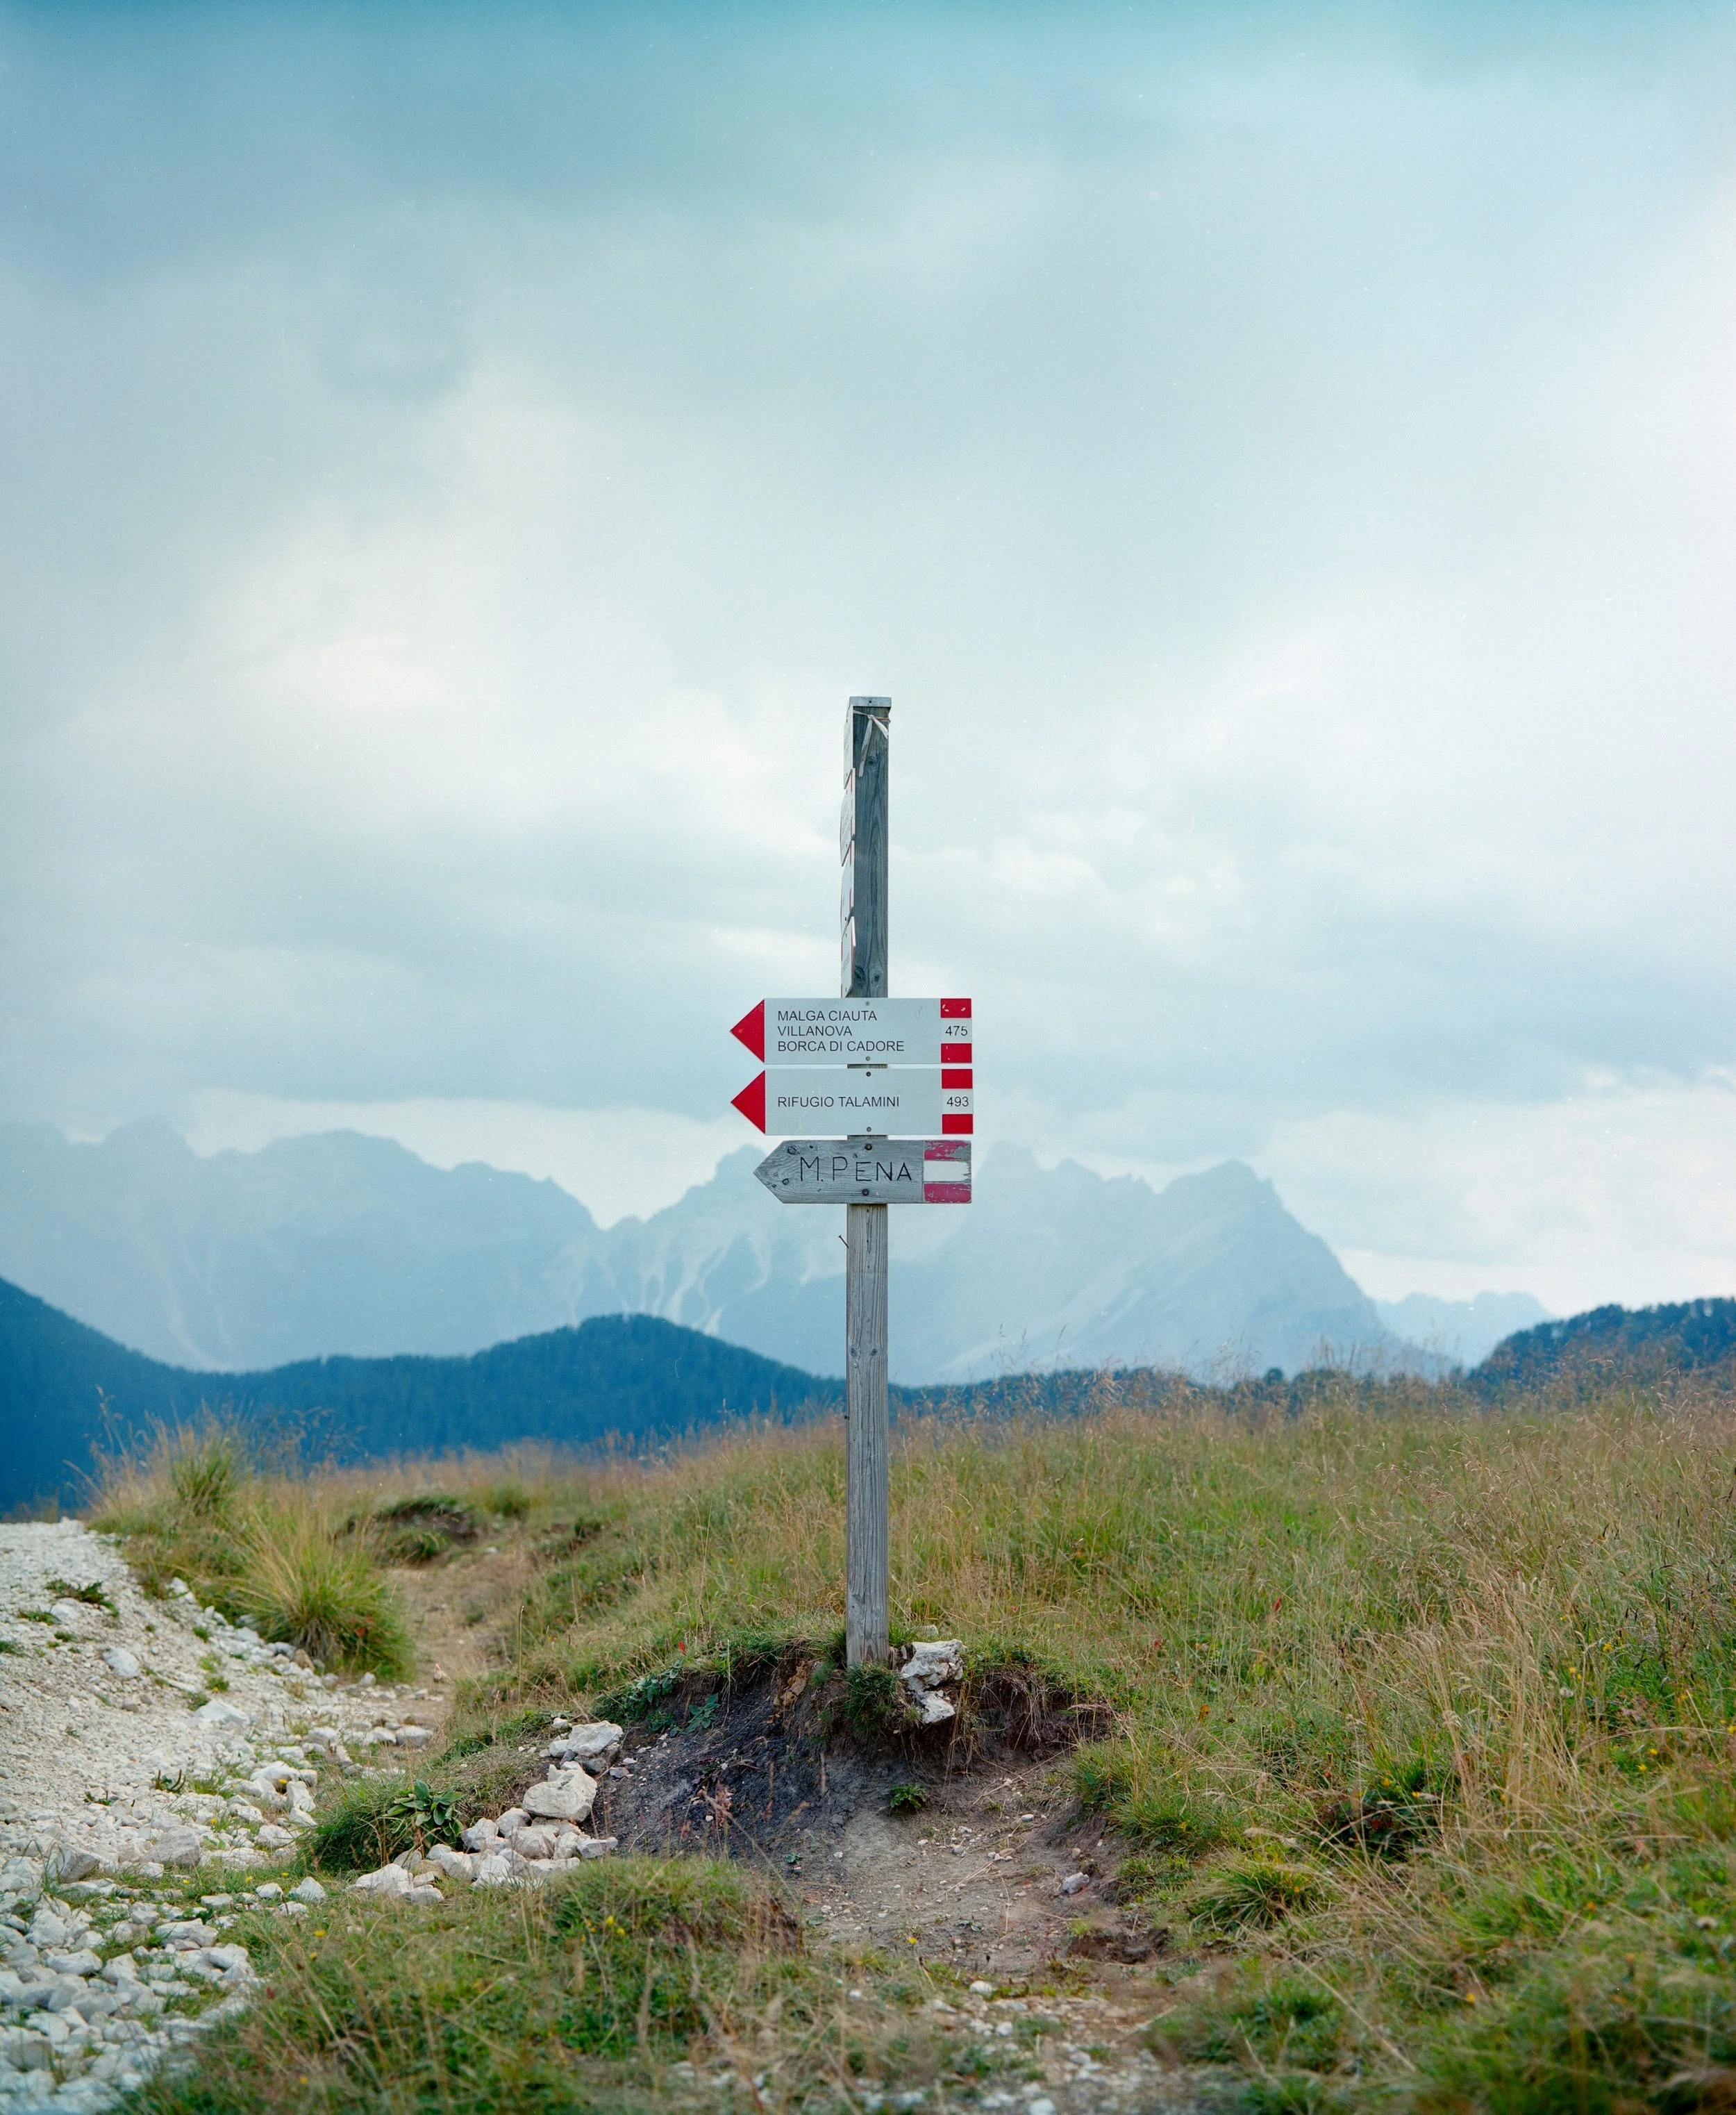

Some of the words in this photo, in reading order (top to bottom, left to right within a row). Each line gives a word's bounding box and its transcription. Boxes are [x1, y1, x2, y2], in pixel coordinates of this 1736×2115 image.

[778, 1010, 826, 1022] MALGA
[828, 1010, 878, 1022] CIAUTA
[778, 1025, 853, 1037] VILLANOVA
[945, 1025, 968, 1036] 475
[778, 1040, 826, 1052] BORCA
[829, 1040, 842, 1052] DI
[846, 1040, 905, 1052] CADORE
[778, 1096, 835, 1108] RIFUGIO
[837, 1096, 900, 1107] TALAMINI
[946, 1096, 969, 1107] 493
